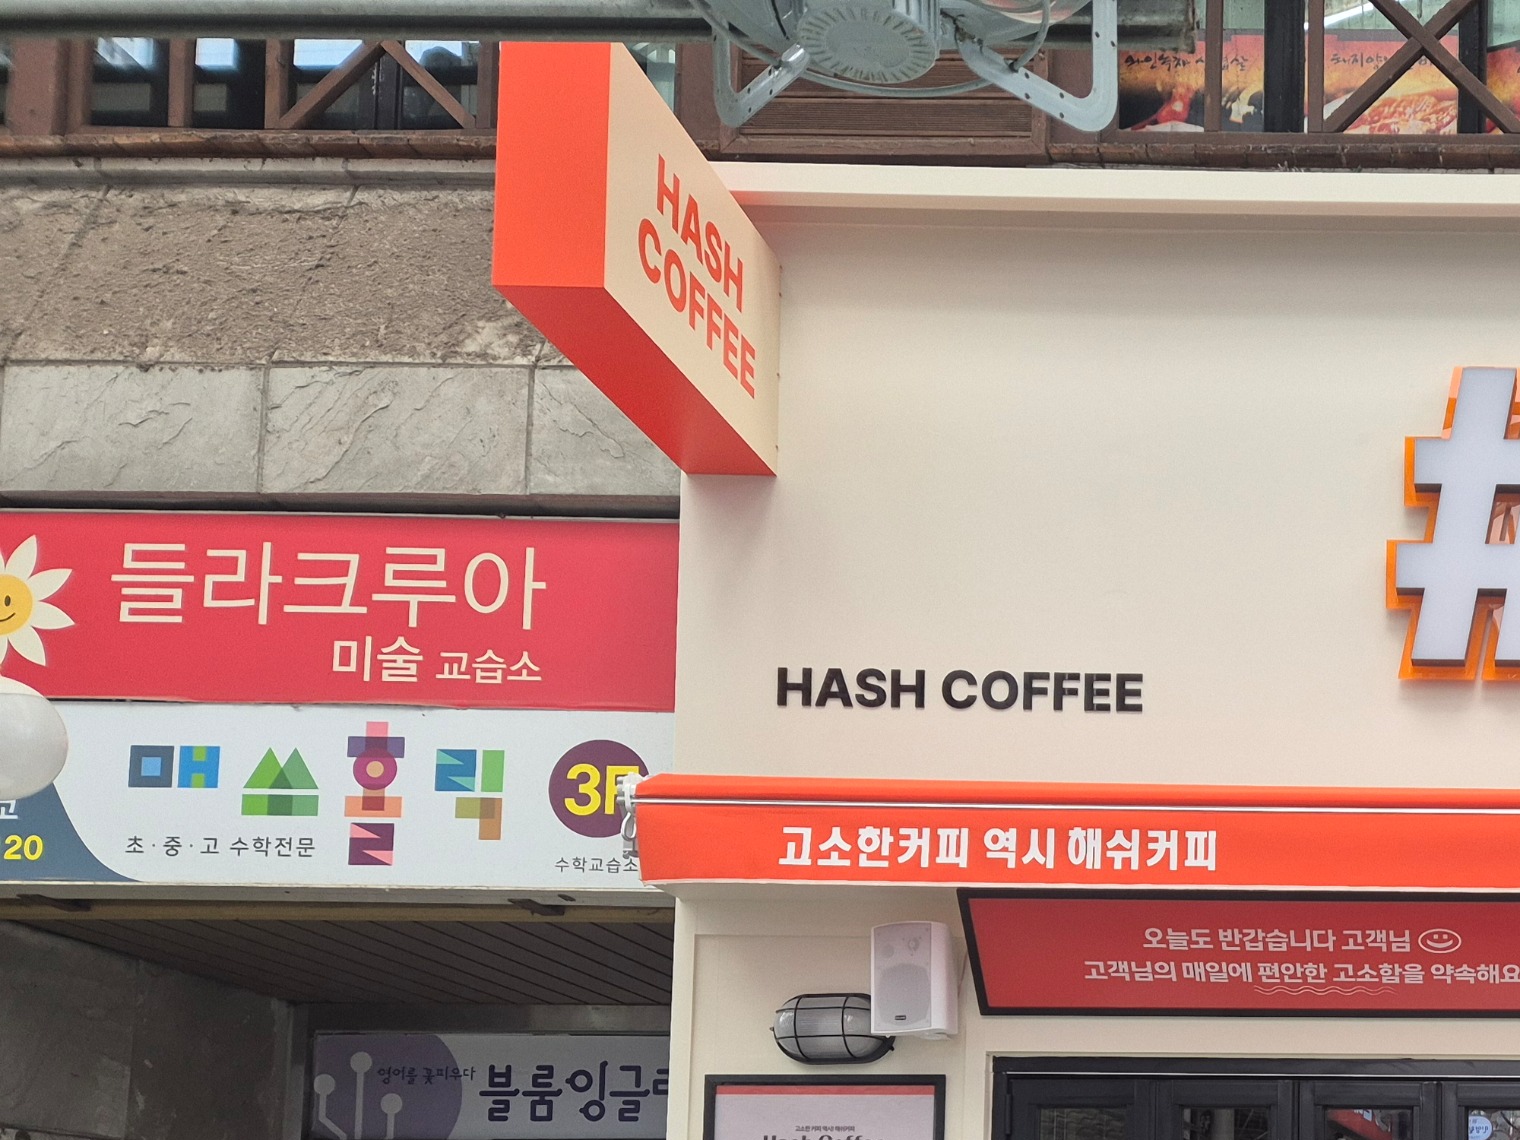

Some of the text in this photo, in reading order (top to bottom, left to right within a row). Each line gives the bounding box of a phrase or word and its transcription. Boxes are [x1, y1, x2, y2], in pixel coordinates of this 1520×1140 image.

[657, 153, 743, 313] HASH
[638, 218, 755, 399] COFFEE
[111, 542, 546, 630] 들라크루아
[332, 636, 542, 682] 미술 교습소
[776, 667, 1144, 713] HASH COFFEE
[229, 835, 316, 859] 수학전문
[779, 825, 1218, 871] 고소한커피 역시 해쉬커피
[1142, 927, 1411, 953] 오늘도 반갑습니다 고객님
[1084, 960, 1176, 983] 고객님의
[1182, 961, 1253, 984] 매일에
[1257, 961, 1326, 984] 편안한
[1332, 962, 1425, 985] 고소함을
[377, 1066, 476, 1086] 영어를 꽃피우다
